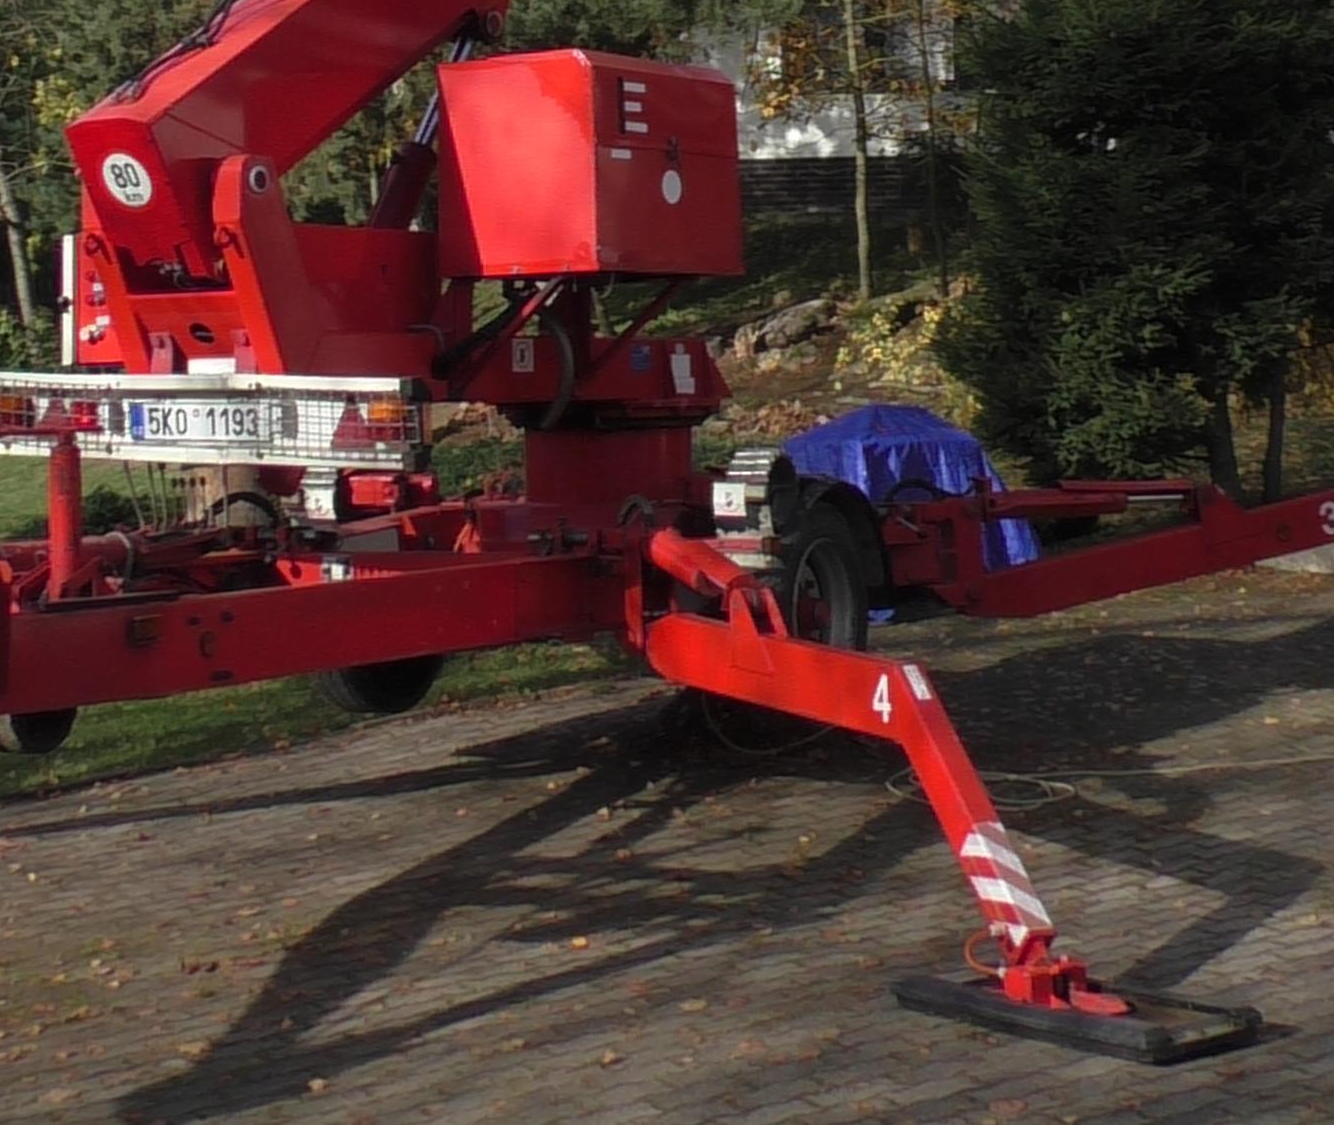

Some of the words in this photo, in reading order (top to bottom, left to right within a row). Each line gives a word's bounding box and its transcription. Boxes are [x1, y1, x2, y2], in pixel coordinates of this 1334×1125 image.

[111, 163, 140, 188] 80
[206, 407, 259, 437] 1193
[872, 673, 892, 724] 4
